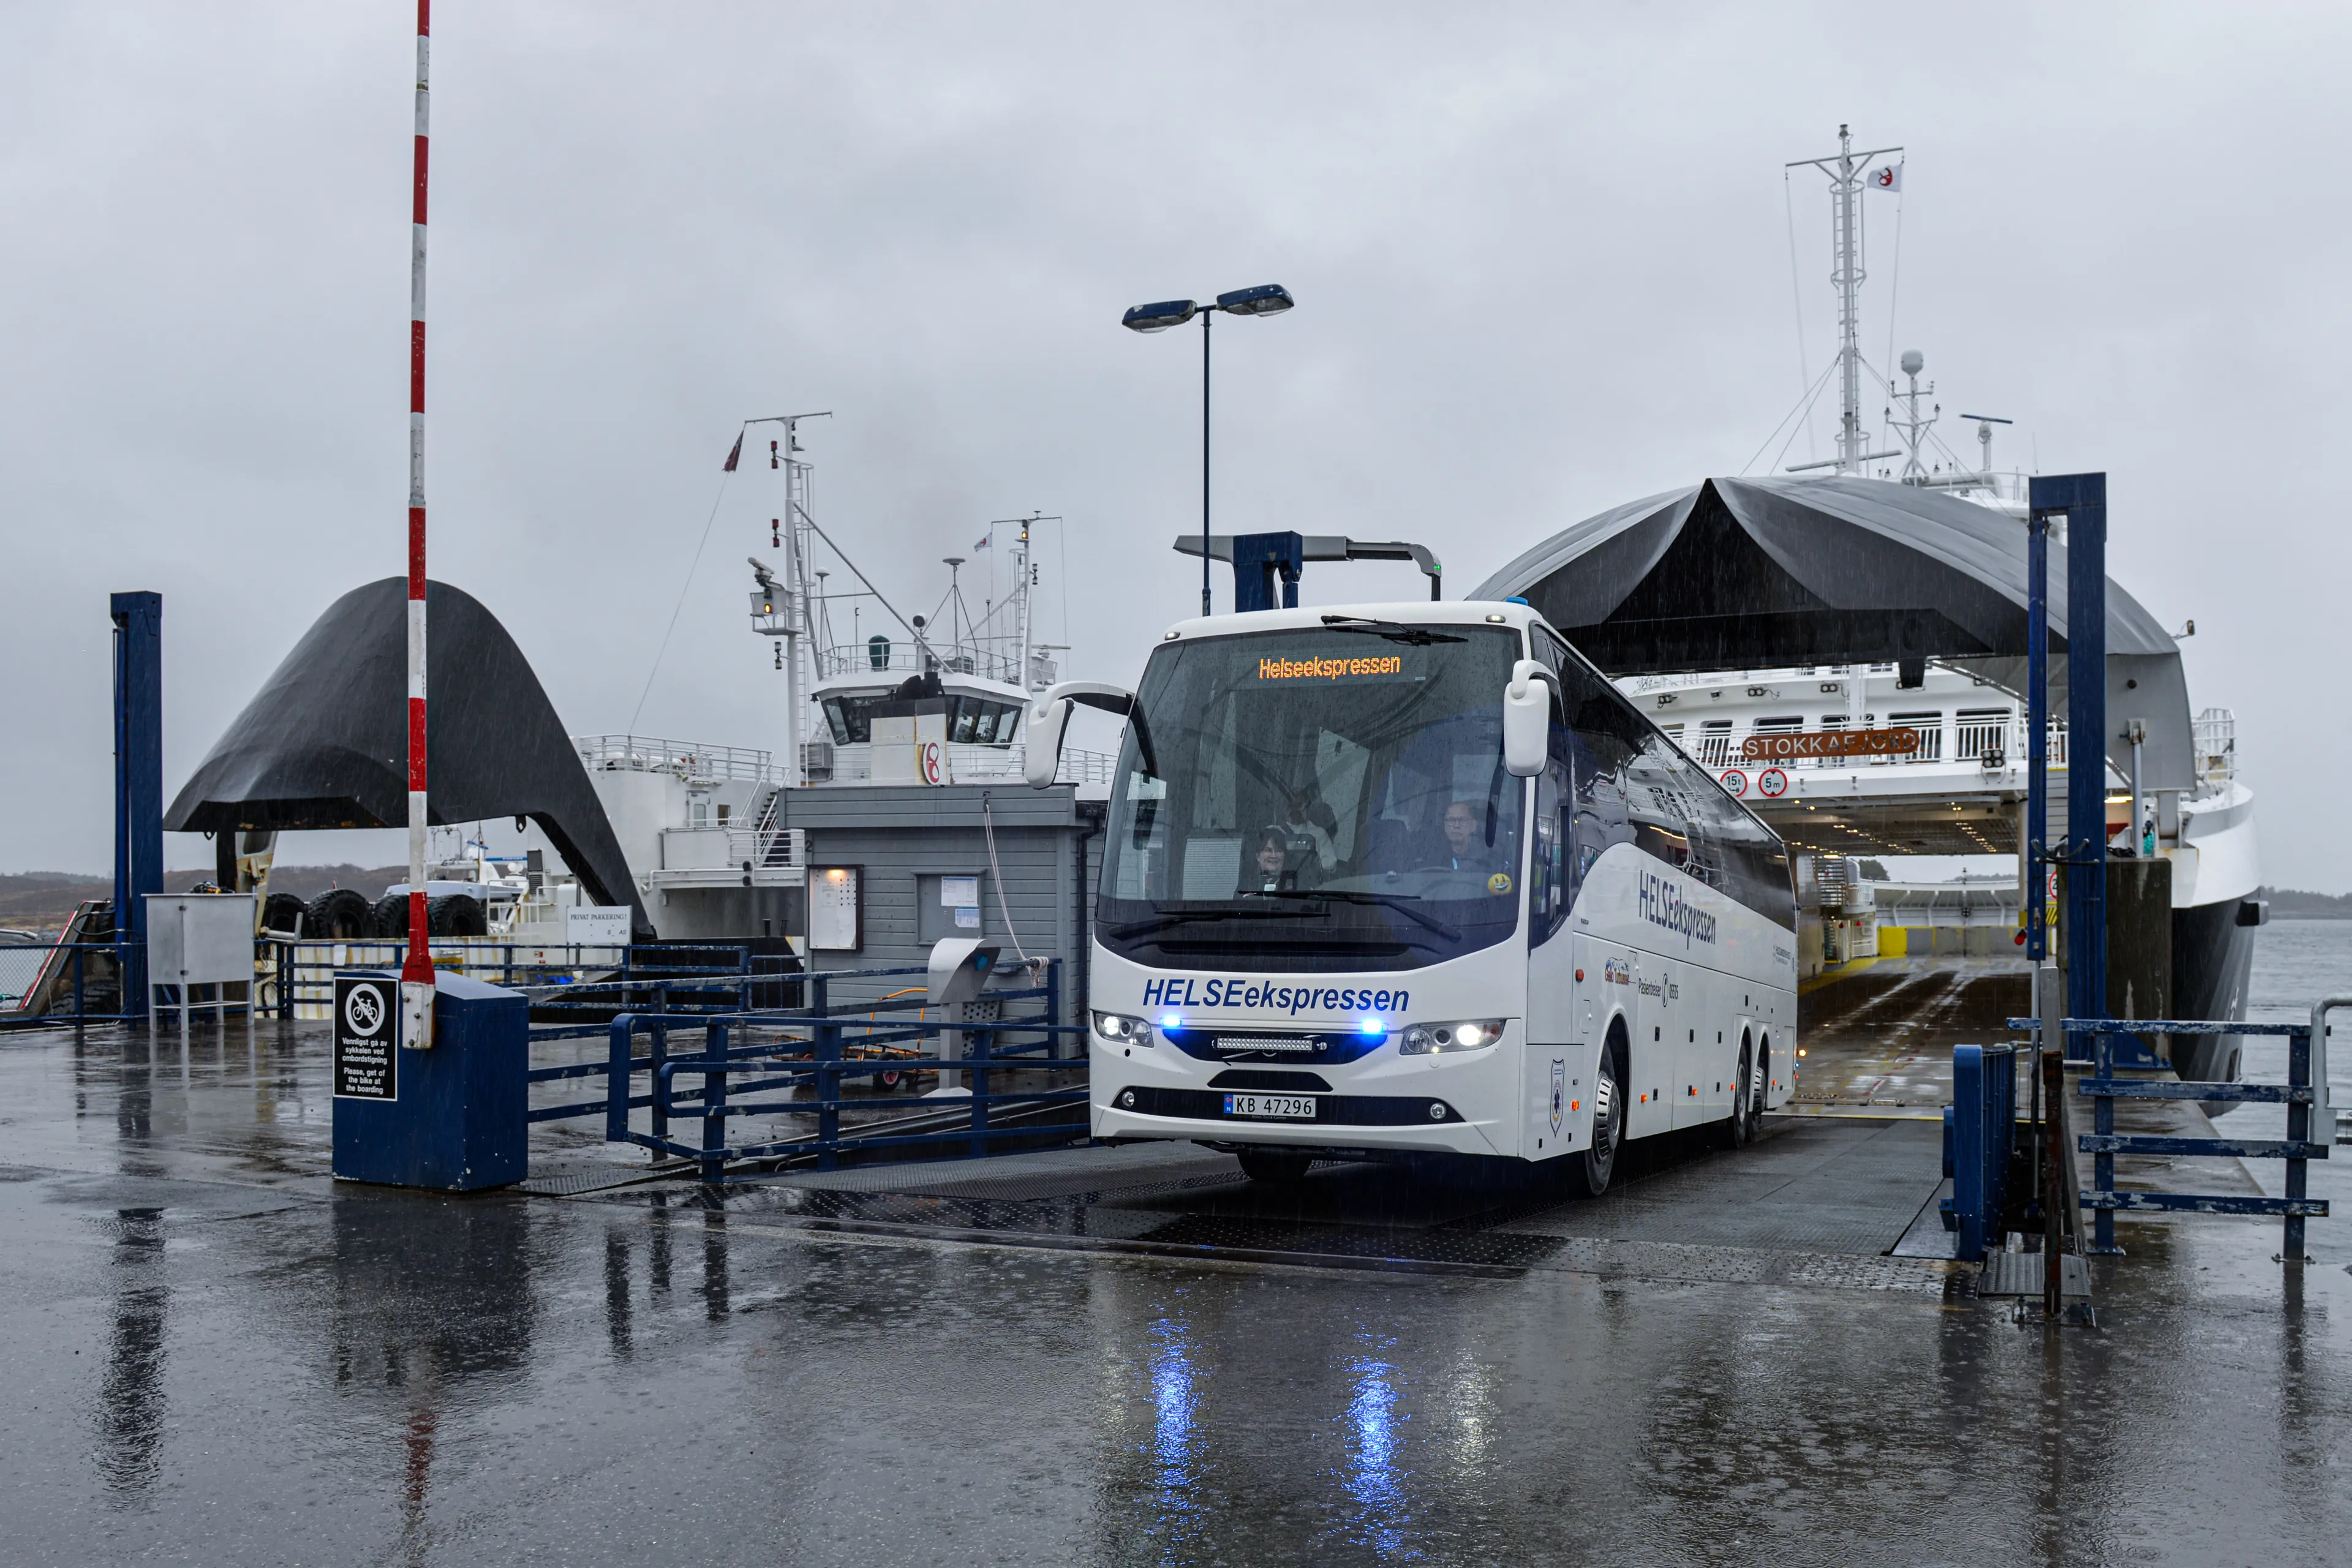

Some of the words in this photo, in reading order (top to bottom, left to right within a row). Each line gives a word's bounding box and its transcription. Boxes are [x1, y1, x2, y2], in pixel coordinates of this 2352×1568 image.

[1259, 656, 1401, 680] Helseekspressen
[1746, 733, 1916, 755] STOKKAFJORD
[805, 840, 813, 852] 2
[1639, 869, 1716, 950] HELSEekspressen
[1142, 979, 1409, 1016] HELSEekspressen
[342, 1038, 369, 1047] Vennligst
[342, 1055, 387, 1065] ombordstigning
[344, 1067, 365, 1076] Please,
[357, 1085, 383, 1095] boarding
[1237, 1098, 1256, 1112] KB
[1264, 1099, 1312, 1115] 47296
